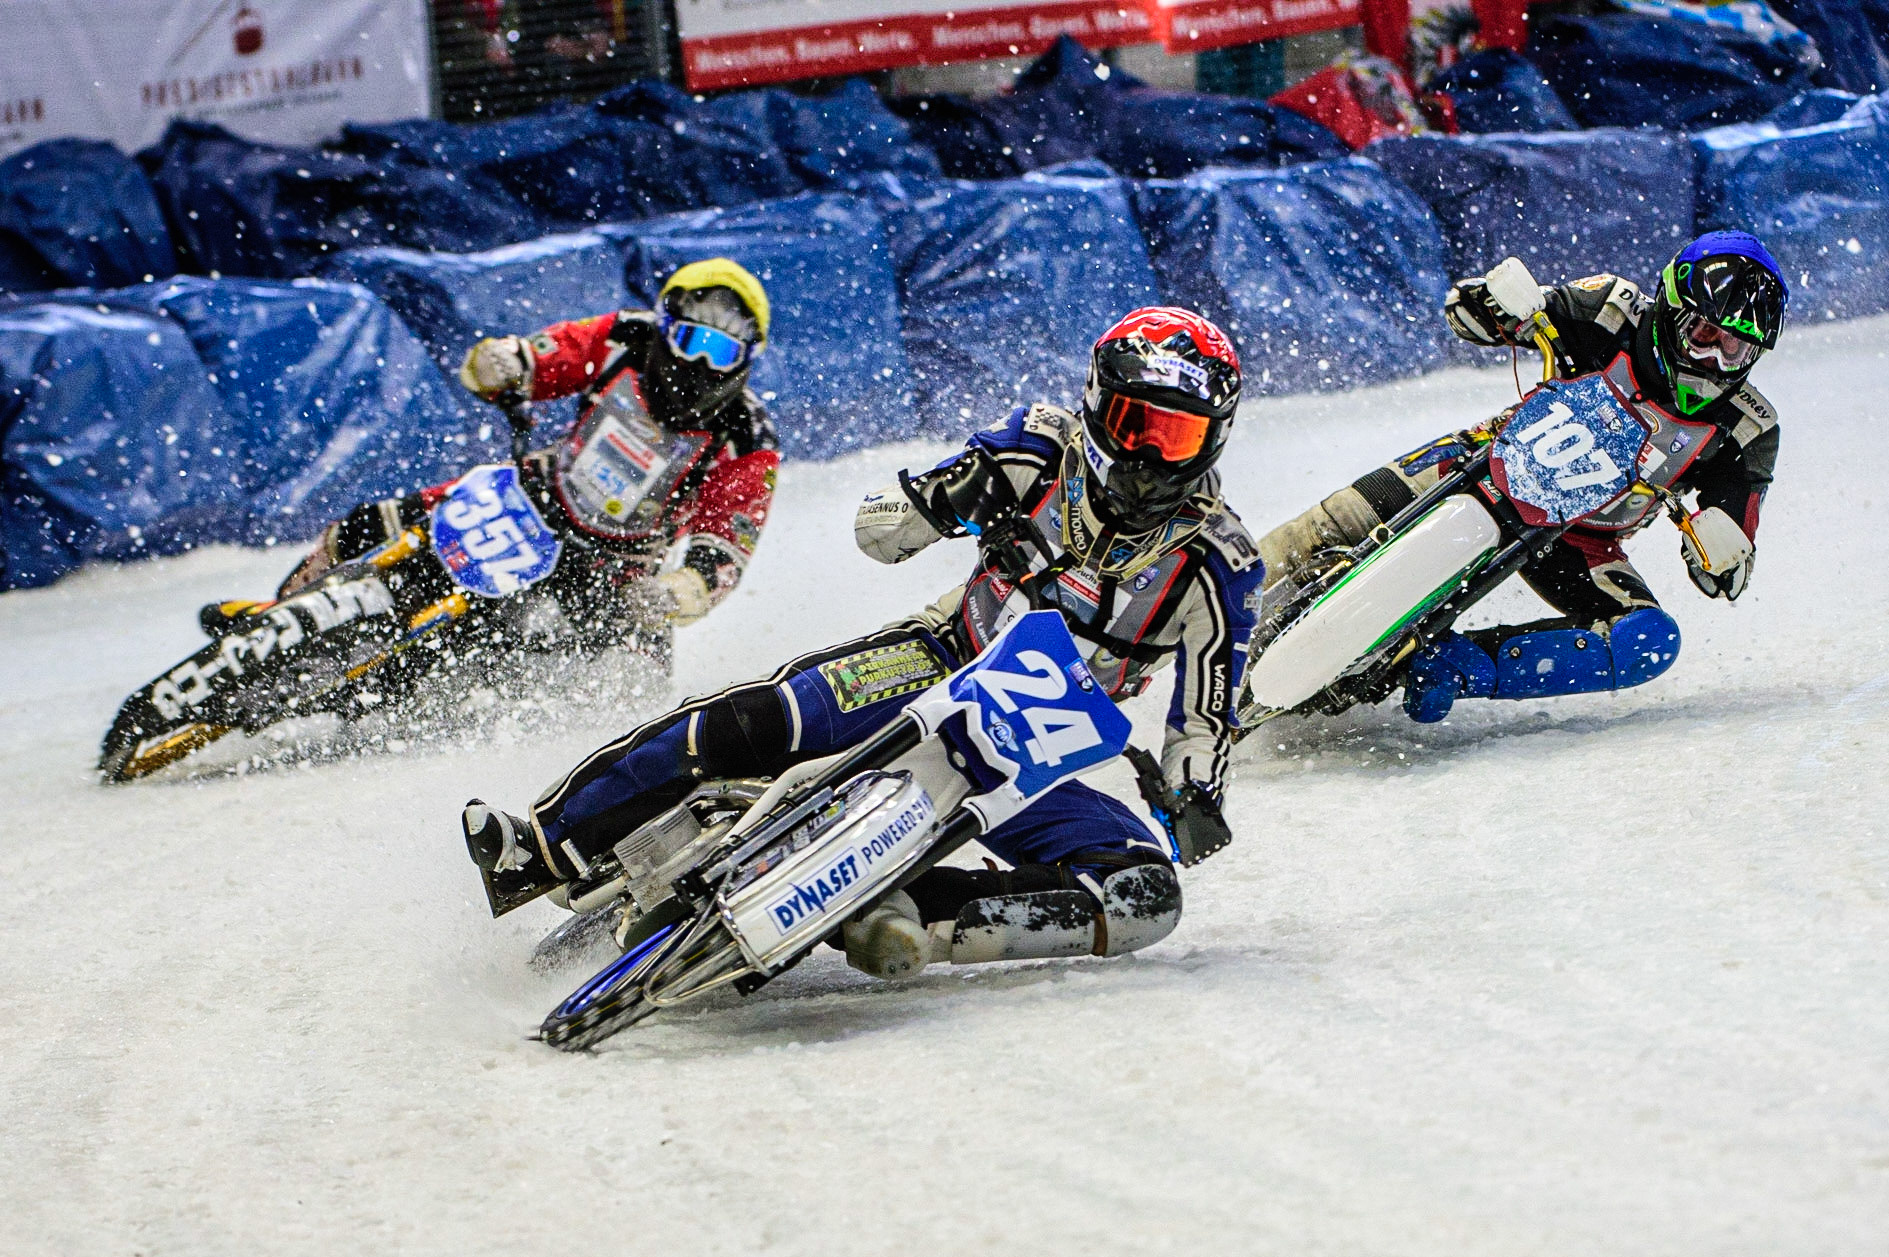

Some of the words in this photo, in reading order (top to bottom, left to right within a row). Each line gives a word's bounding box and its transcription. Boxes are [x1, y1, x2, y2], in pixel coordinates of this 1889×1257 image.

[1154, 357, 1205, 378] DYNASET
[1515, 400, 1623, 491] 107
[444, 488, 541, 579] 357
[1071, 506, 1087, 551] moveo
[972, 649, 1104, 768] 24
[1211, 663, 1226, 712] WACO
[773, 853, 860, 930] DYNASET
[861, 809, 918, 865] POWERED
